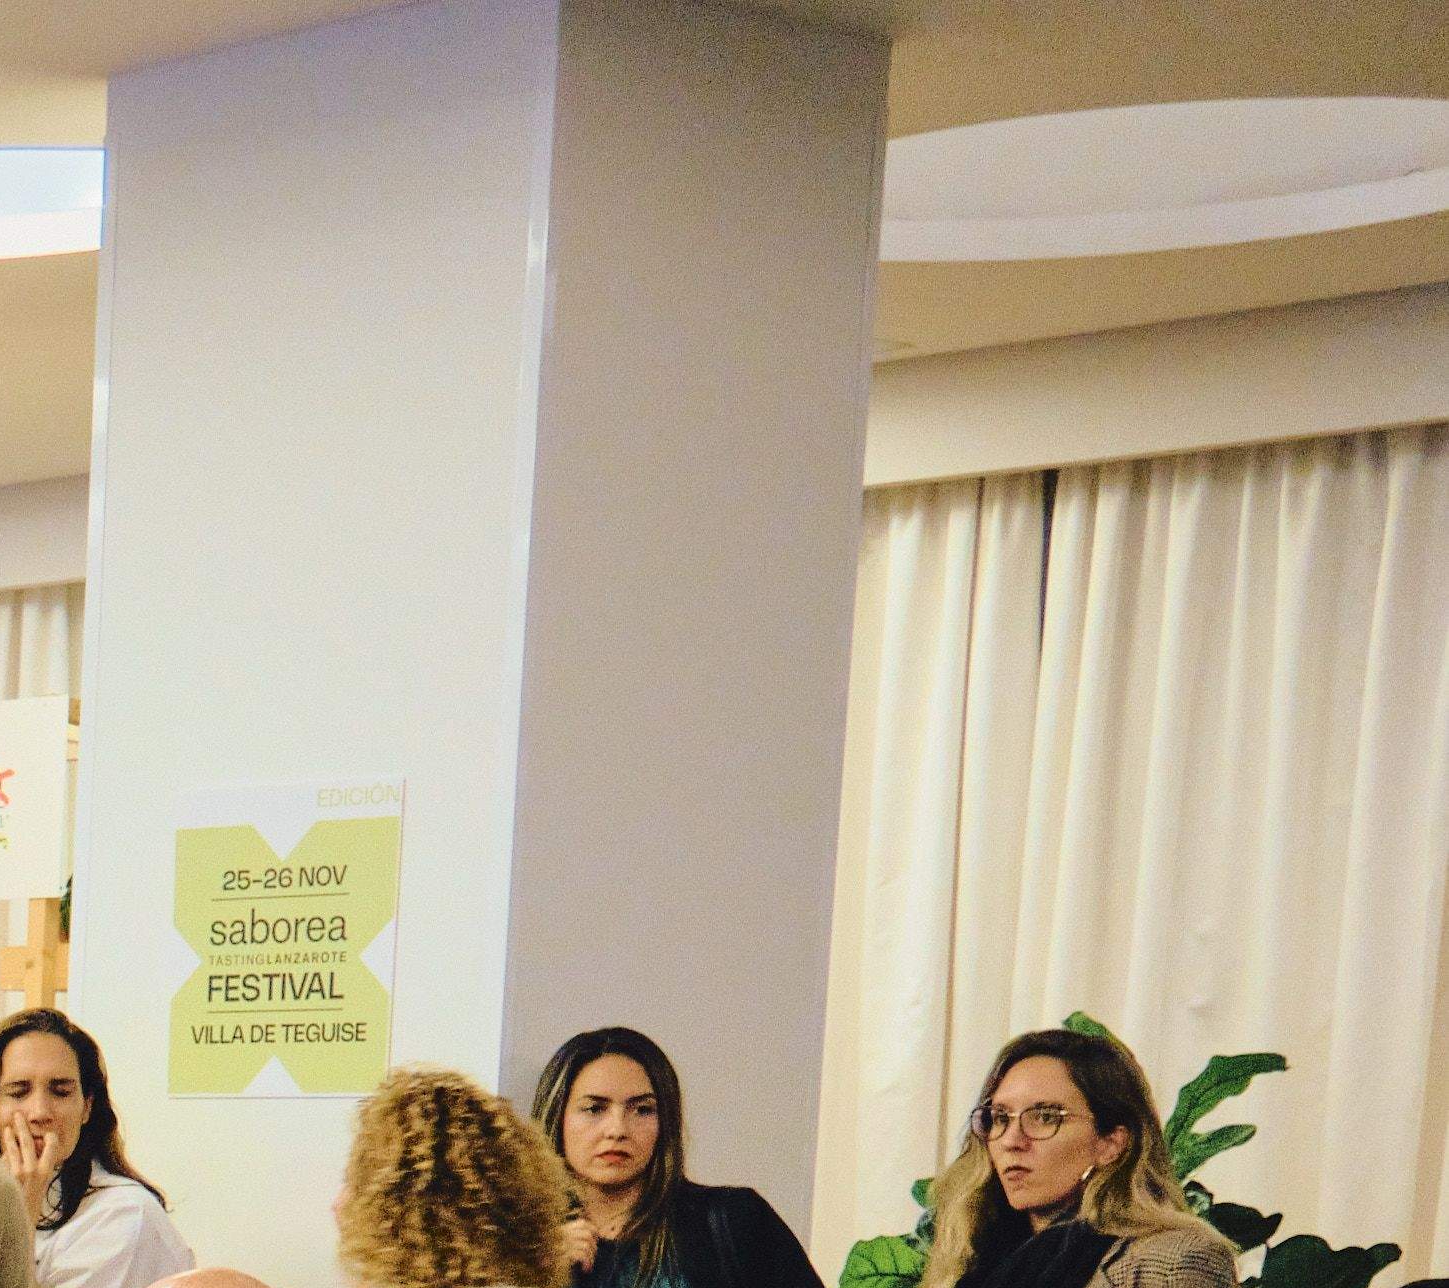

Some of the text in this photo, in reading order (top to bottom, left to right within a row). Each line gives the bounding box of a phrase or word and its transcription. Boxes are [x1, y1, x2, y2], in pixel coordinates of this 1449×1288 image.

[317, 784, 401, 808] EDICIÓN
[299, 865, 347, 888] NOV
[210, 907, 347, 946] saborea
[208, 971, 344, 1002] FESTIVAL
[191, 1022, 367, 1044] VILLA DE TEGUISE
